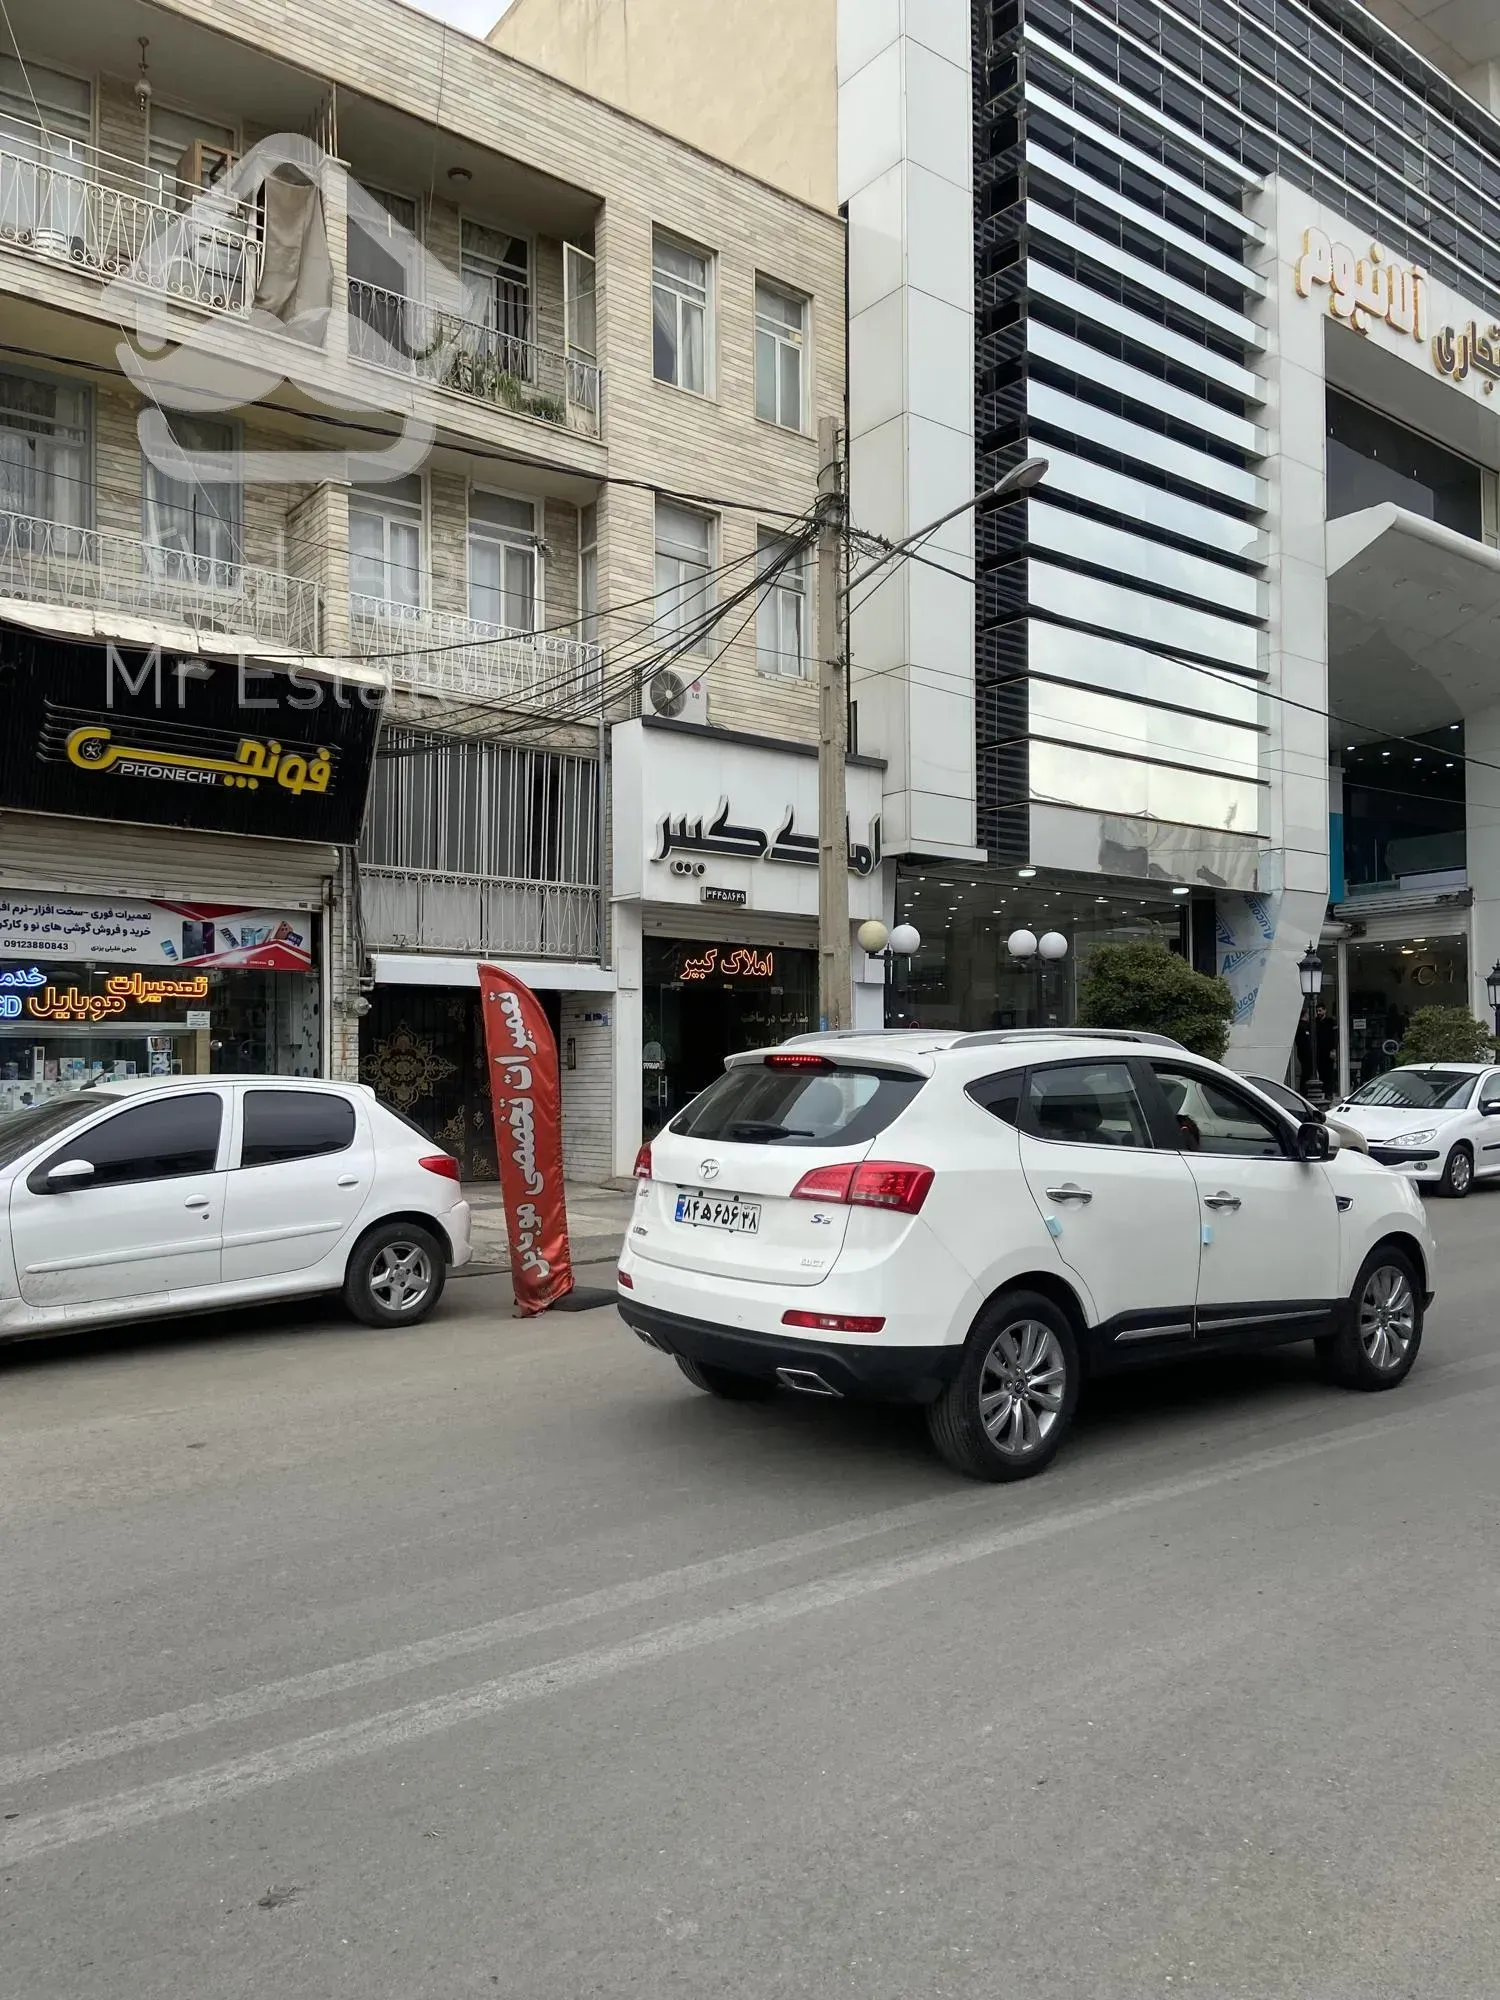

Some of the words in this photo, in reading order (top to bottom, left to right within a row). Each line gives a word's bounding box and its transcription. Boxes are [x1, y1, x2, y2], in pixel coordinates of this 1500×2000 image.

[120, 763, 217, 785] PHONECHI
[650, 793, 769, 877] کبیر
[90, 907, 113, 920] فوری
[115, 910, 152, 921] تعمیرات
[23, 923, 29, 931] و
[31, 922, 39, 931] نو
[42, 922, 61, 932] های
[63, 921, 92, 934] گوشی
[92, 924, 121, 936] فروش
[123, 928, 128, 936] و
[129, 927, 151, 937] خرید
[4, 940, 69, 950] 09123880843
[680, 949, 717, 979] کبیر
[721, 949, 772, 976] املاک
[106, 972, 208, 1003] تعمیرات
[28, 986, 126, 1021] موبایل
[765, 1014, 776, 1026] در
[489, 990, 538, 1091] تعمیرات
[499, 1097, 545, 1196] تخصصی
[515, 1202, 551, 1278] موبایل
